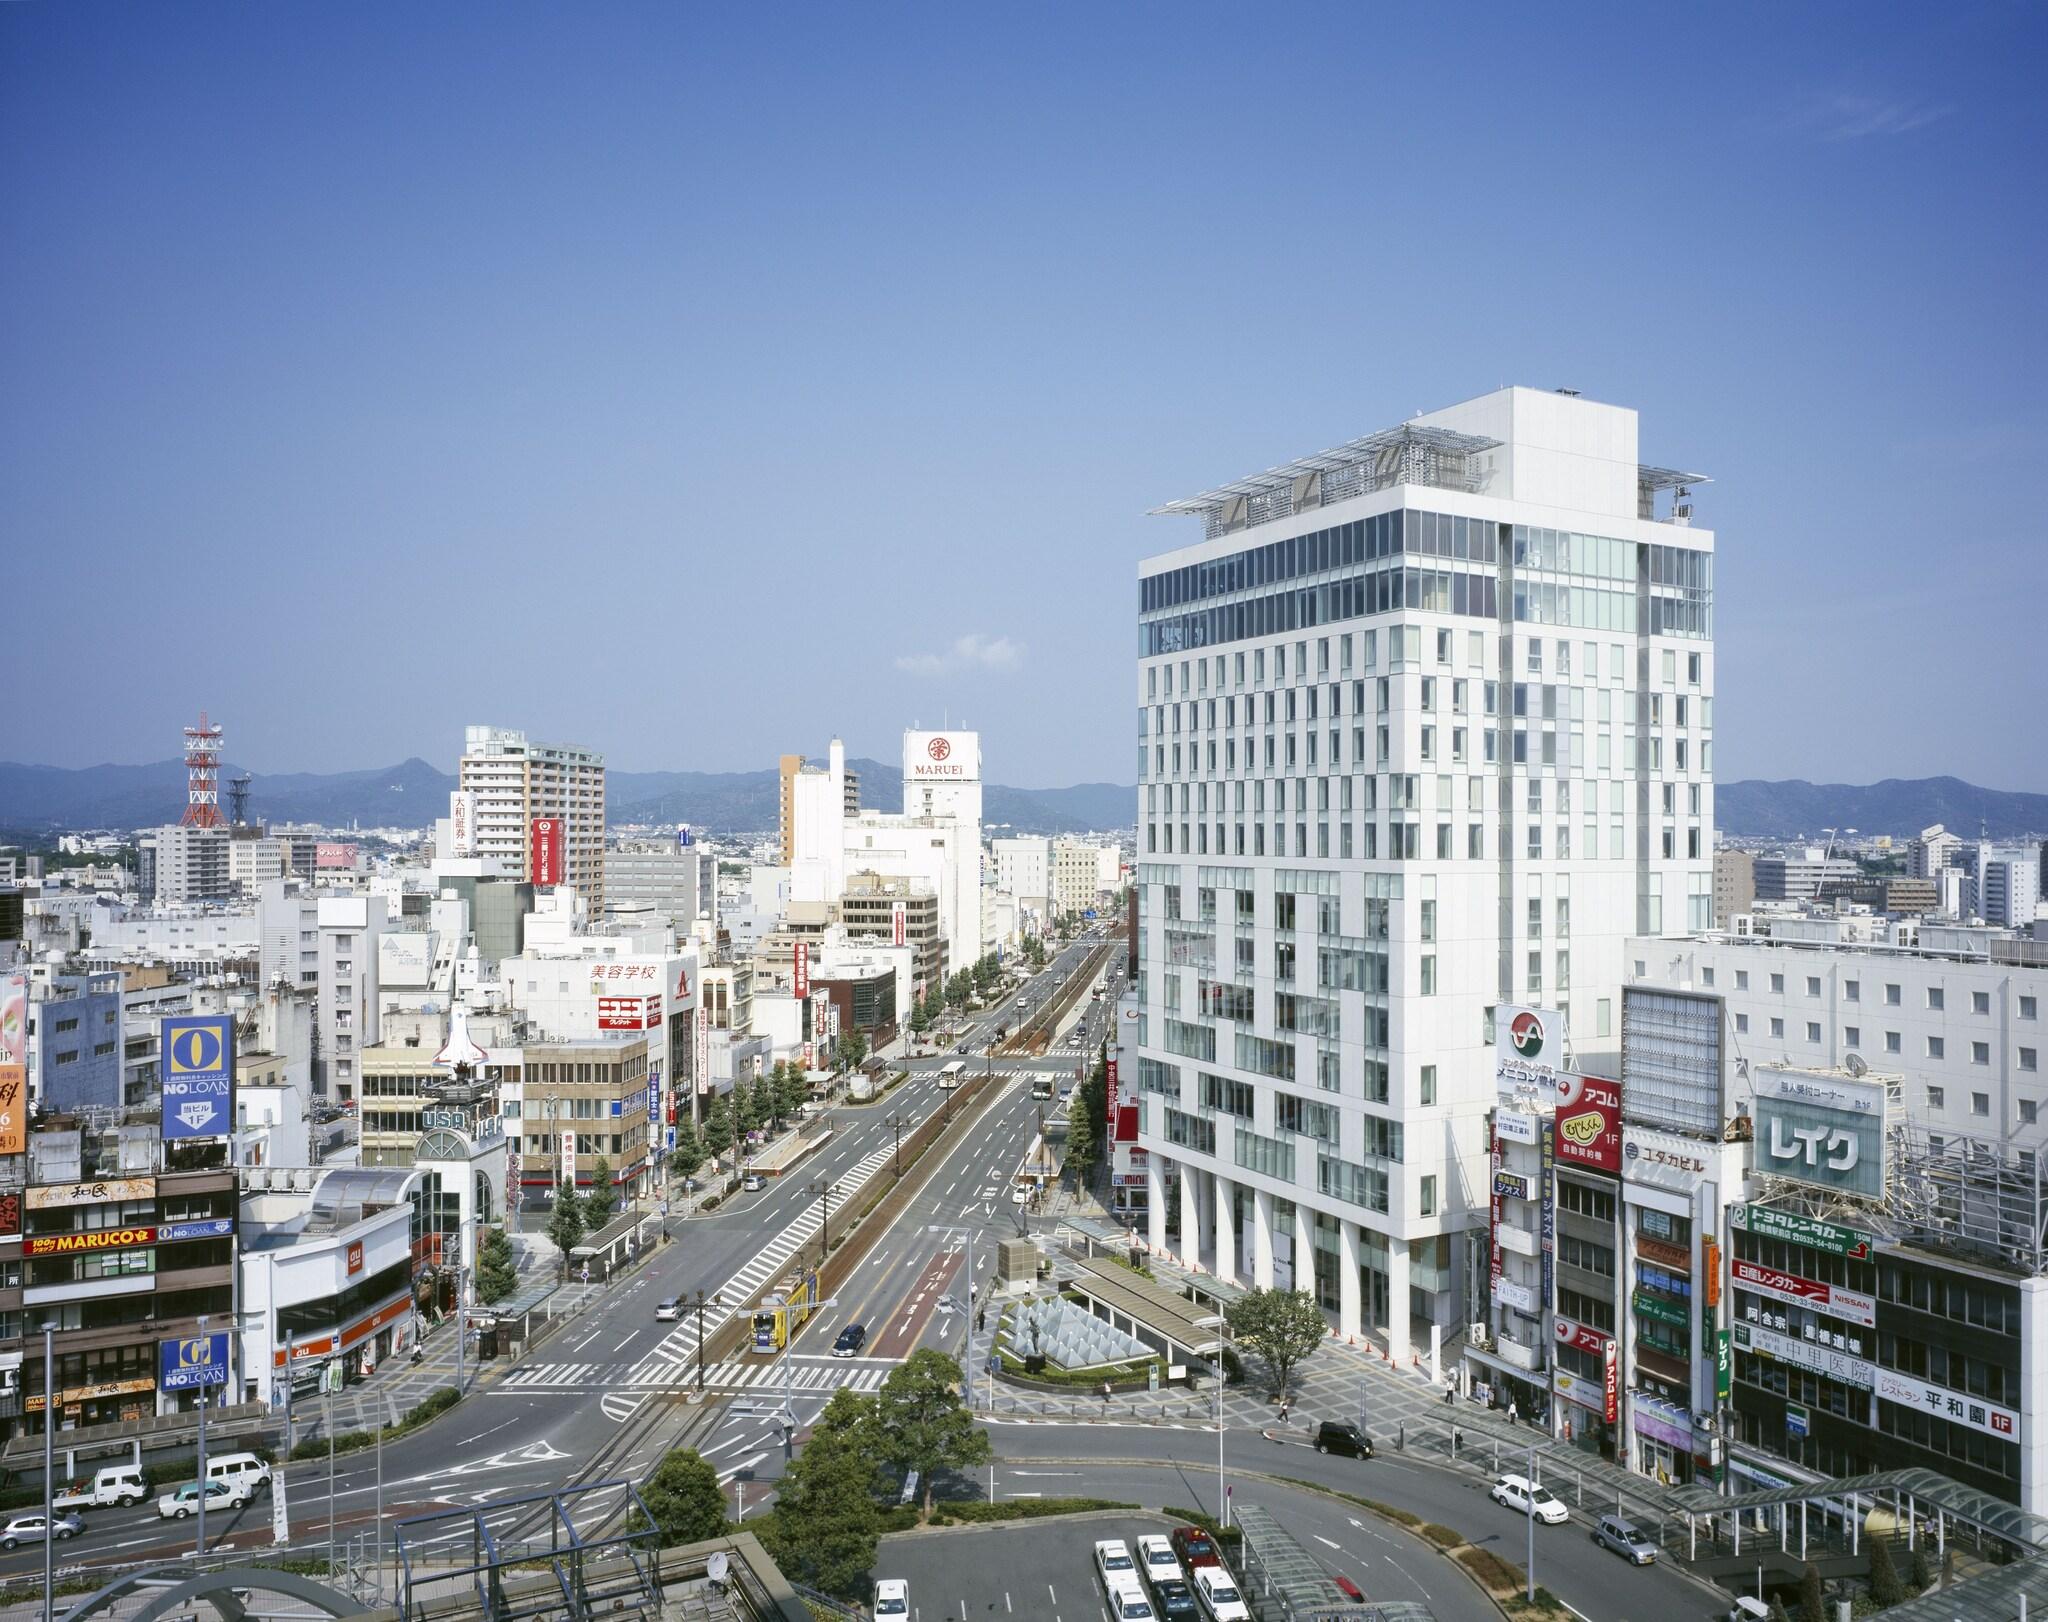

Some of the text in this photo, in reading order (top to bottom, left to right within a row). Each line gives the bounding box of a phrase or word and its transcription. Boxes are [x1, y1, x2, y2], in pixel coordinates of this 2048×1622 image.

[590, 964, 657, 980] 美容学校
[1584, 1087, 1619, 1109] アコム
[183, 1104, 210, 1114] 当ビル
[188, 1115, 204, 1124] 1F
[422, 1111, 465, 1129] USA
[1565, 1121, 1602, 1138] むじんくん
[1605, 1133, 1619, 1144] 1F
[1563, 1143, 1603, 1161] 自動契約機
[1770, 1116, 1859, 1171] レイク
[1643, 1147, 1705, 1173] ユタカビル
[1497, 1182, 1521, 1197] ジオス
[1751, 1208, 1847, 1240] トヨタレンタカー
[56, 1230, 134, 1252] MARUCO
[350, 1249, 361, 1262] au
[1738, 1263, 1803, 1291] 日産レンタカー
[1779, 1292, 1828, 1312] 0532-33-9923
[1834, 1294, 1871, 1310] NISSAN
[372, 1316, 381, 1327] au
[1747, 1306, 1787, 1331] 阿含宗
[1579, 1332, 1601, 1350] アコ
[296, 1346, 309, 1357] au
[1718, 1338, 1728, 1371] レイク
[1785, 1340, 1870, 1384] 中里医院
[1606, 1366, 1616, 1394] アコム
[1881, 1382, 1921, 1403] レストラン
[1994, 1415, 2010, 1431] 1F
